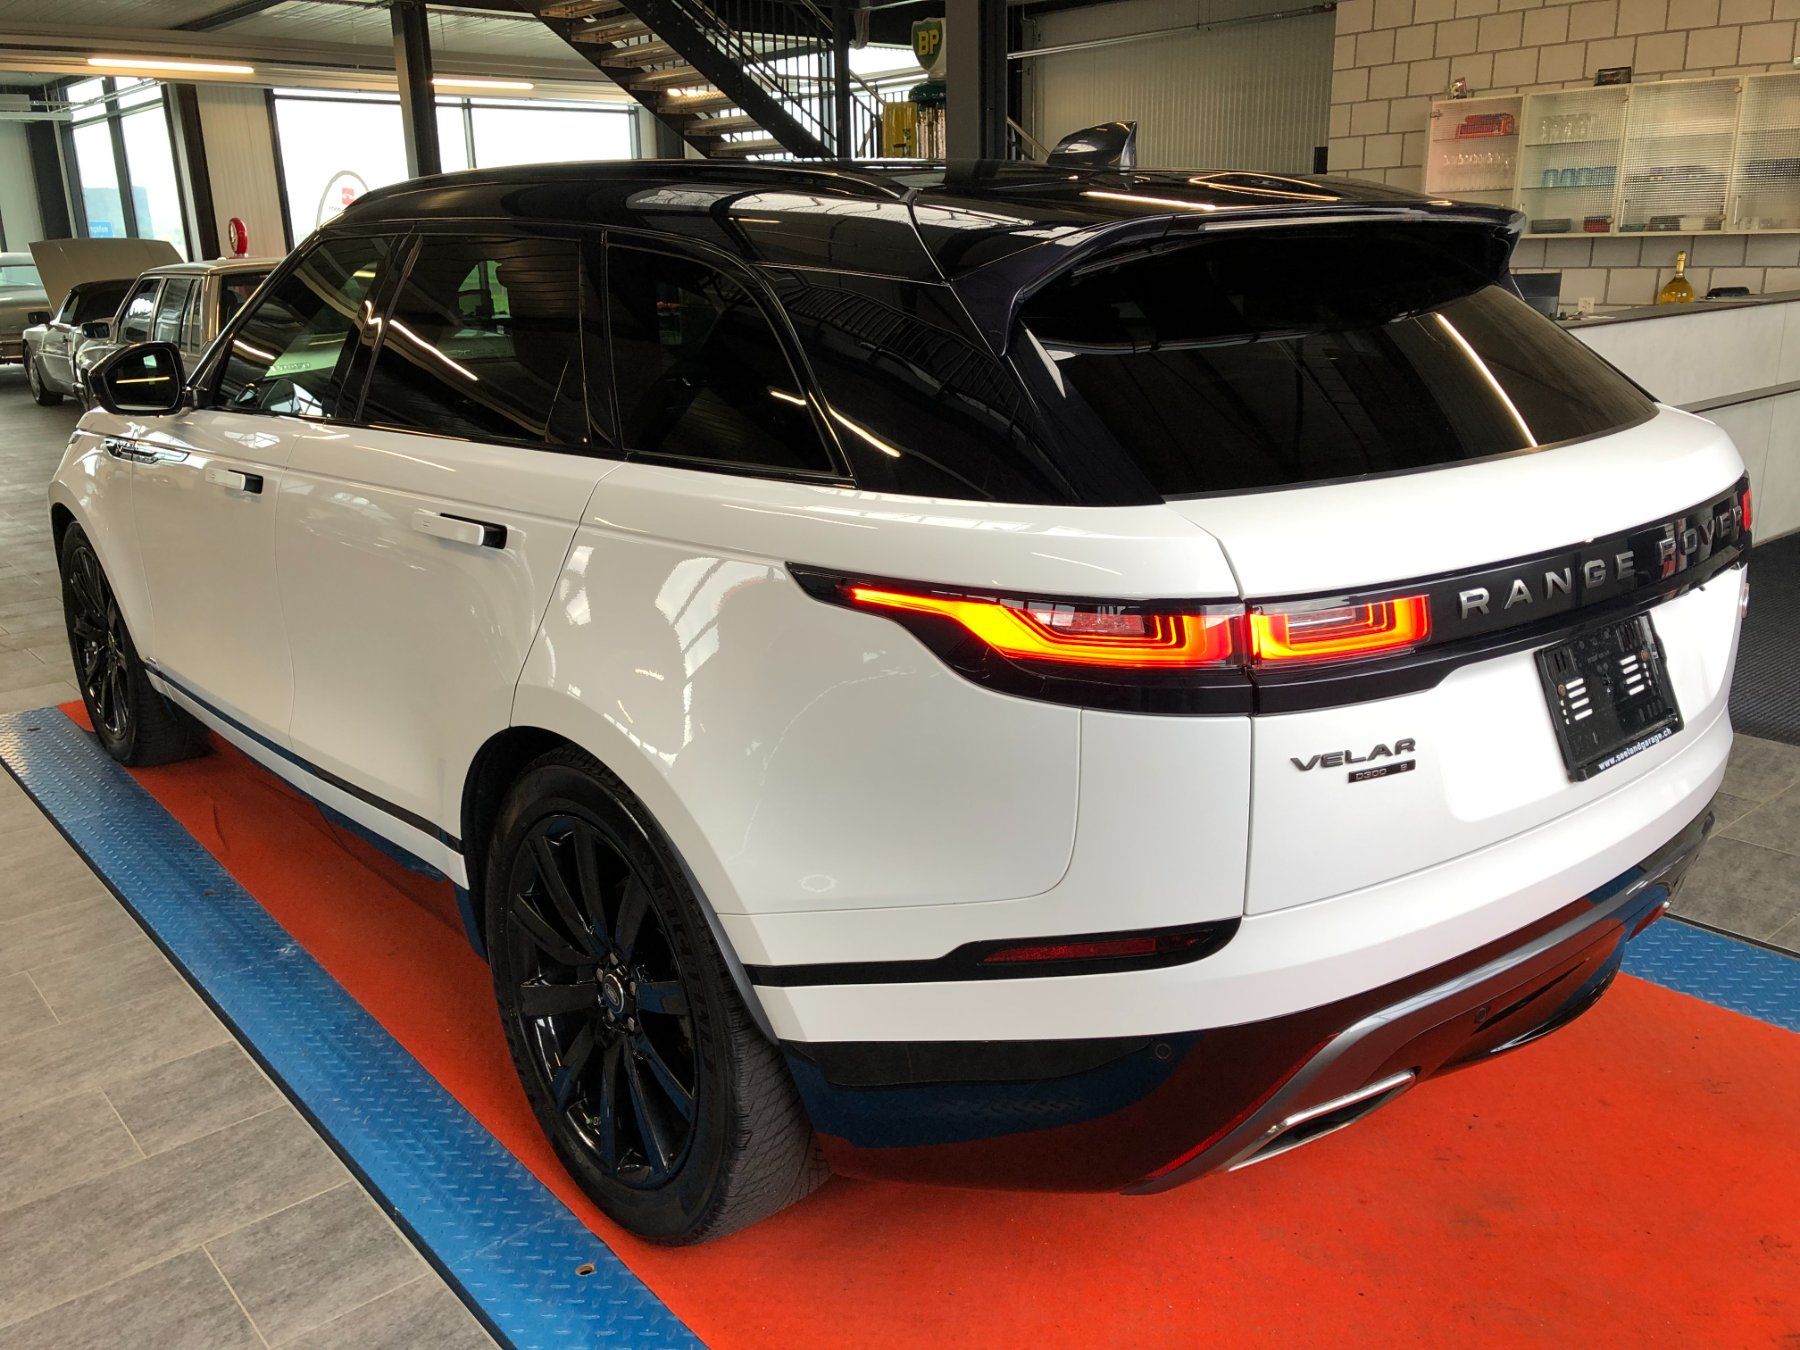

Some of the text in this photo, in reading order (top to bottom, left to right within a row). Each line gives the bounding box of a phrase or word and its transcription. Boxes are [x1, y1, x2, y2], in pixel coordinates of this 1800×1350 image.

[918, 29, 940, 55] BP
[1458, 505, 1742, 620] RANGE ROVER
[1290, 738, 1416, 771] VELAR
[1598, 727, 1672, 770] www.seelandgarage.ch
[1355, 768, 1387, 780] D300
